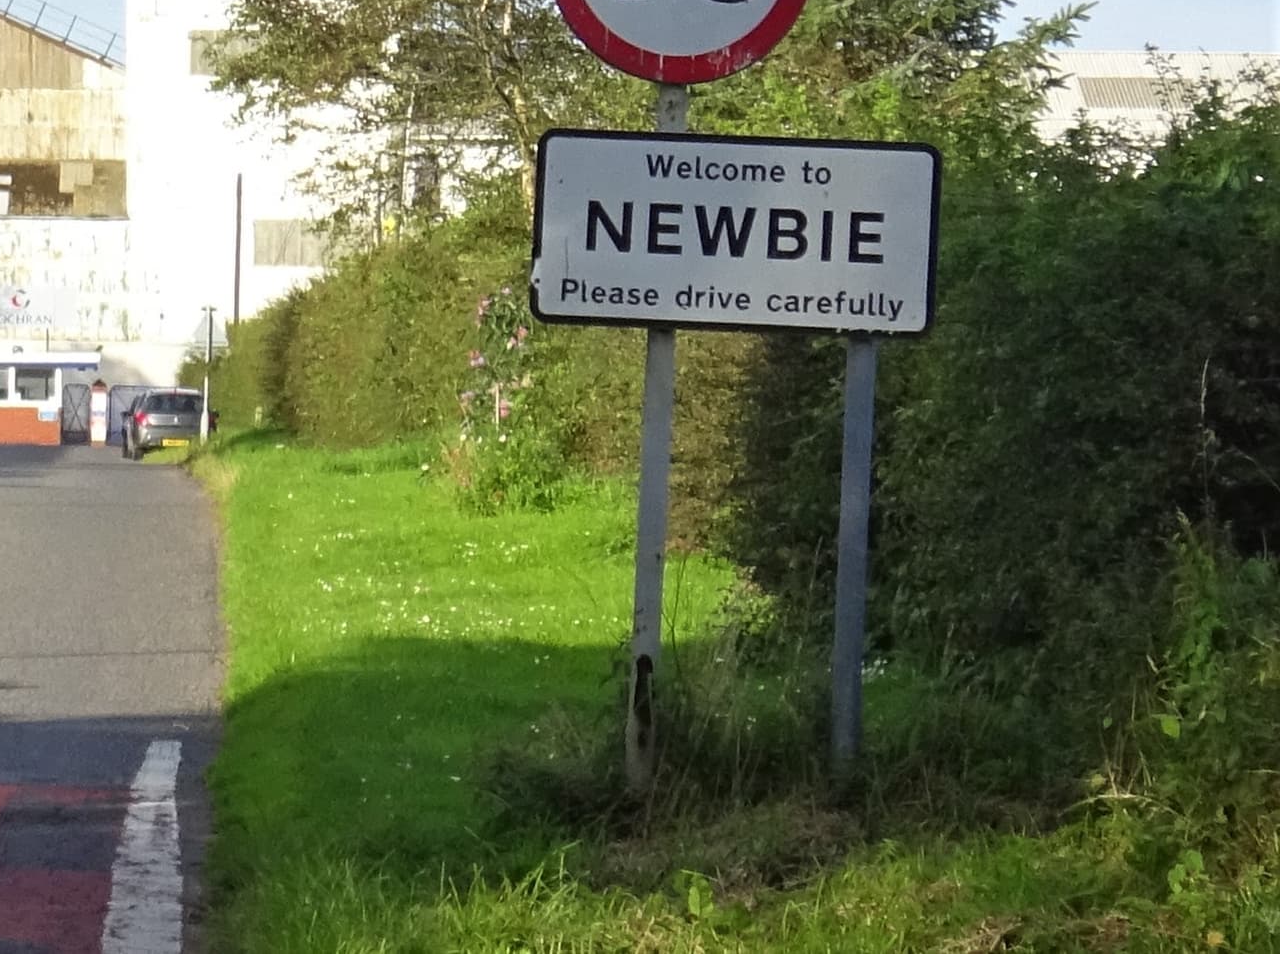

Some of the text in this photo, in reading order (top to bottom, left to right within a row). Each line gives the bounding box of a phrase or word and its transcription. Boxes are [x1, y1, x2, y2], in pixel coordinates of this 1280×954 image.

[646, 154, 833, 186] Welcome to
[585, 199, 886, 265] NEWBIE
[560, 278, 905, 323] Please drive carefully
